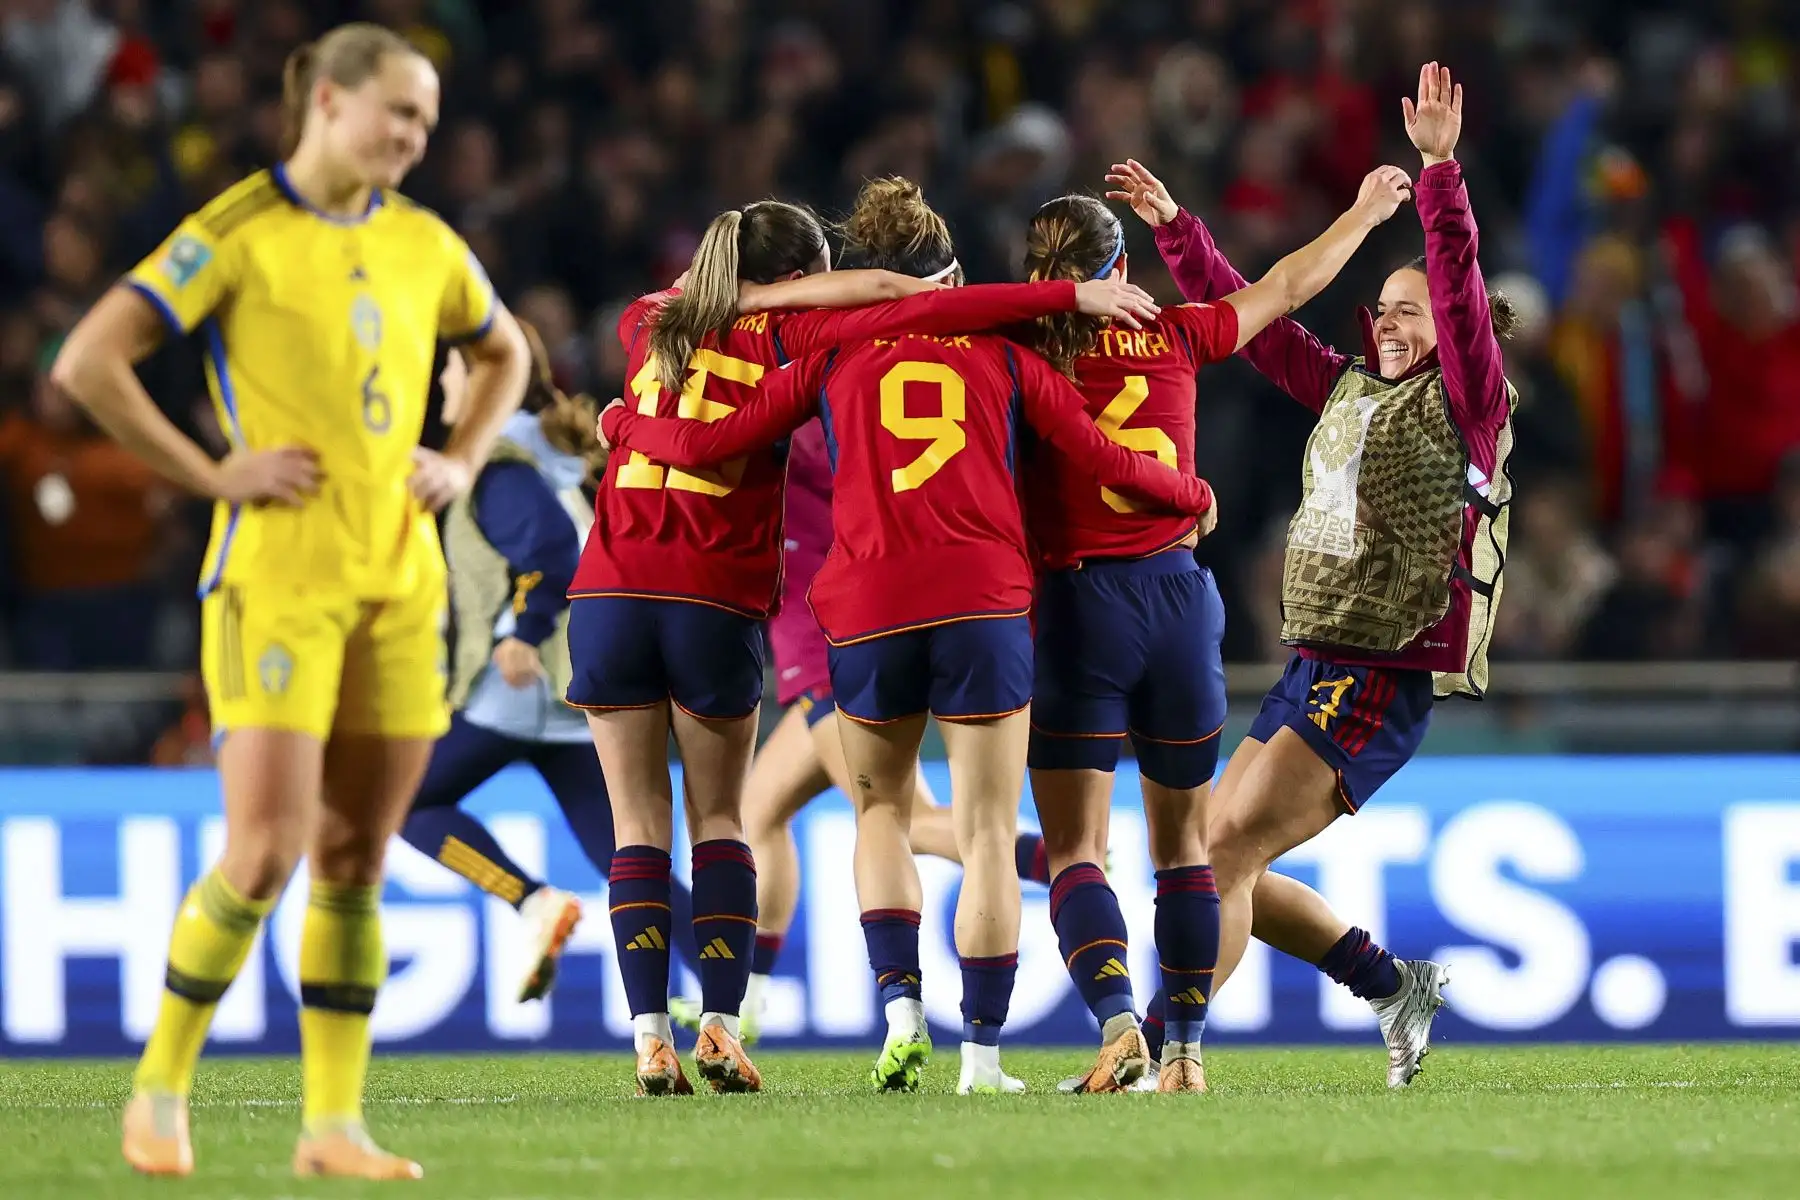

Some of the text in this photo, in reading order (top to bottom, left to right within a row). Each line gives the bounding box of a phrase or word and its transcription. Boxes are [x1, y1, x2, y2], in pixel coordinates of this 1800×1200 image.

[361, 362, 392, 437] 6
[615, 349, 765, 498] 15
[880, 361, 966, 494] 9
[1095, 375, 1178, 514] 6
